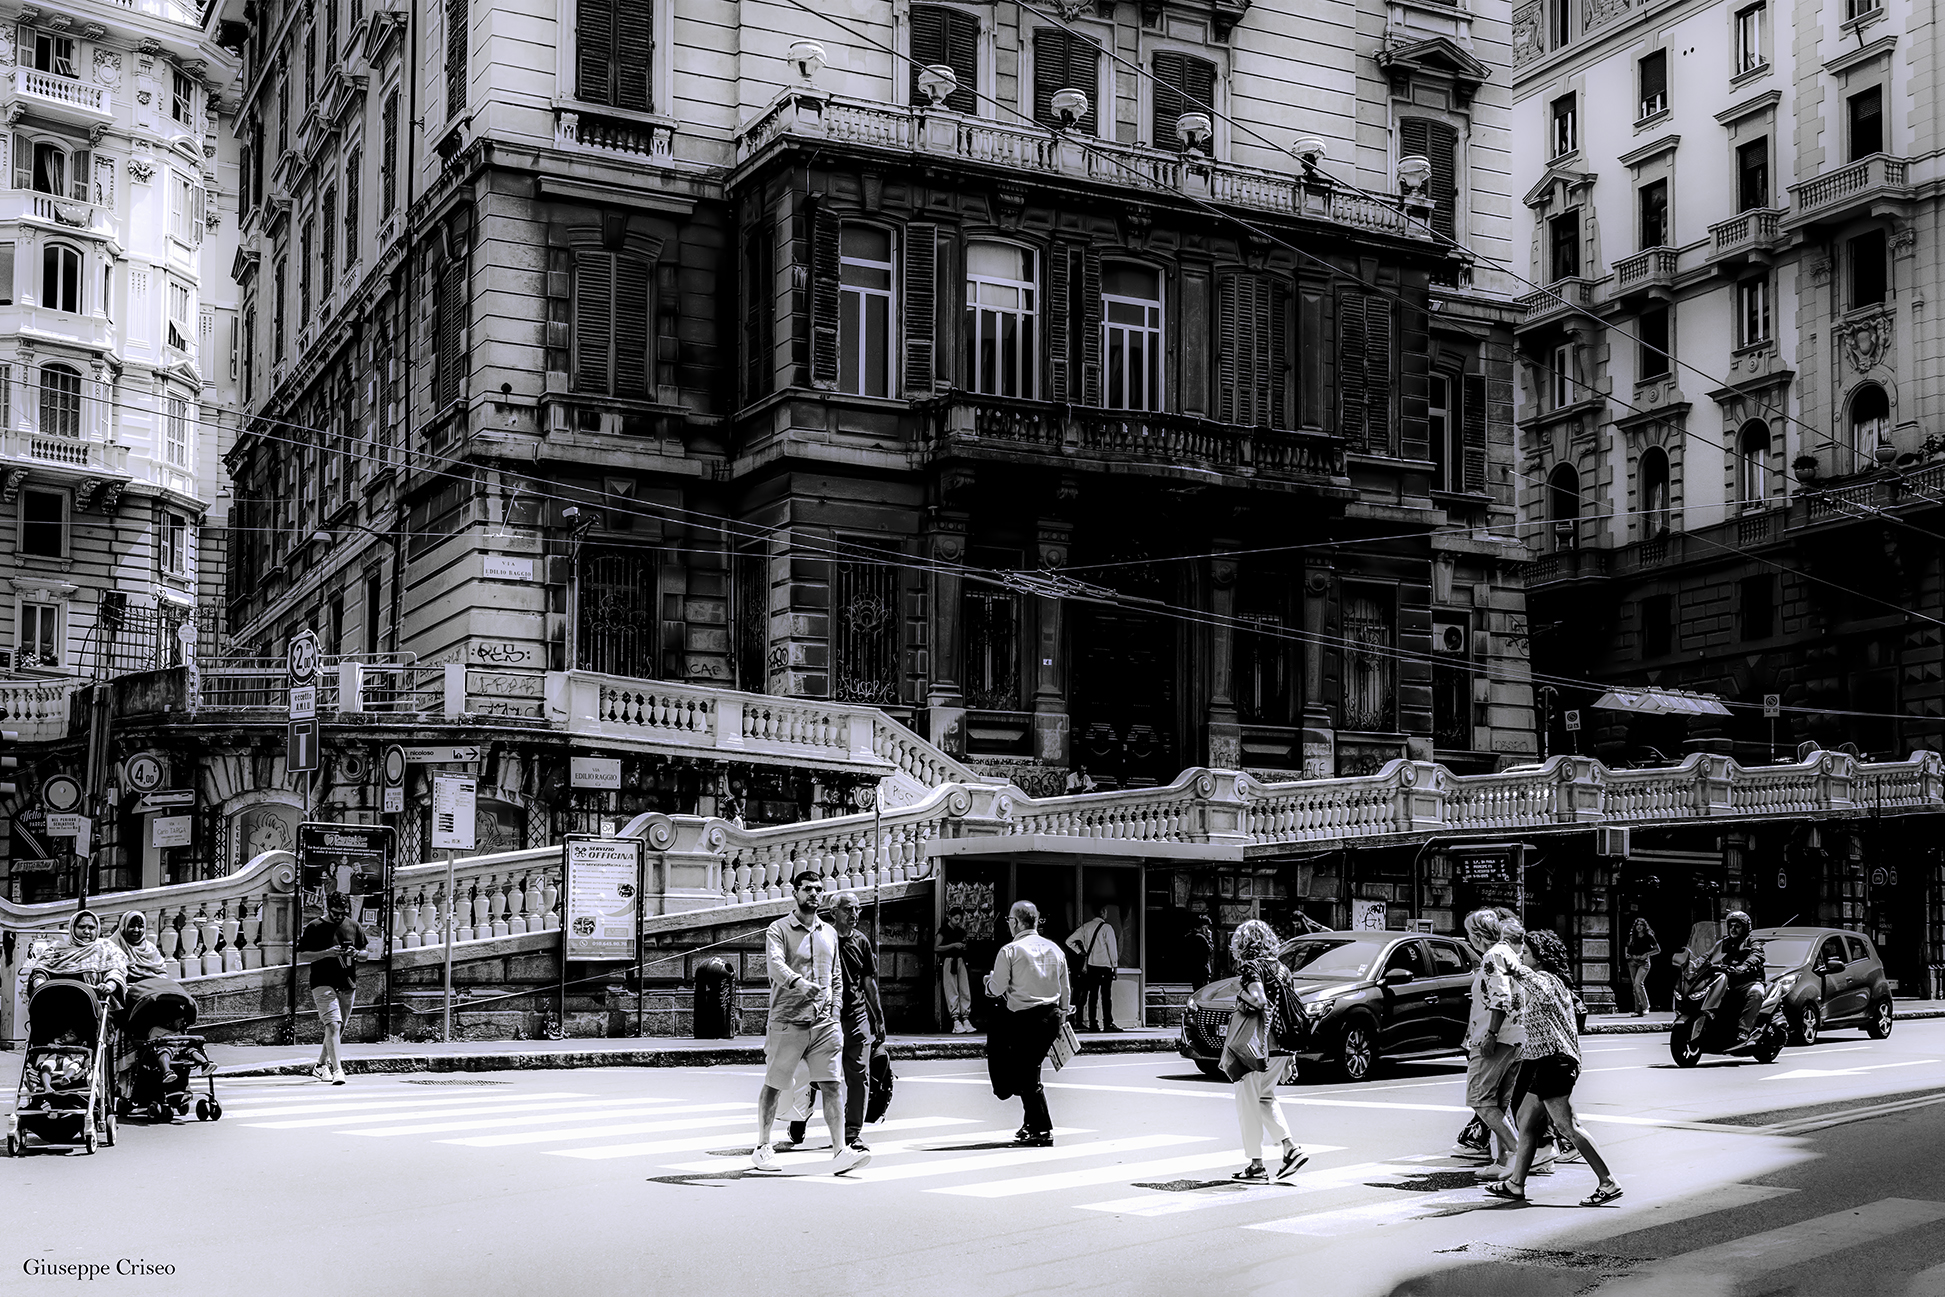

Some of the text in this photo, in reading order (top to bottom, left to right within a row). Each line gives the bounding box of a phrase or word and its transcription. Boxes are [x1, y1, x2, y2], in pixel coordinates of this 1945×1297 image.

[294, 692, 312, 702] eccetto
[574, 772, 618, 781] EDILIO RAGGIO
[588, 851, 634, 860] OFFICINA
